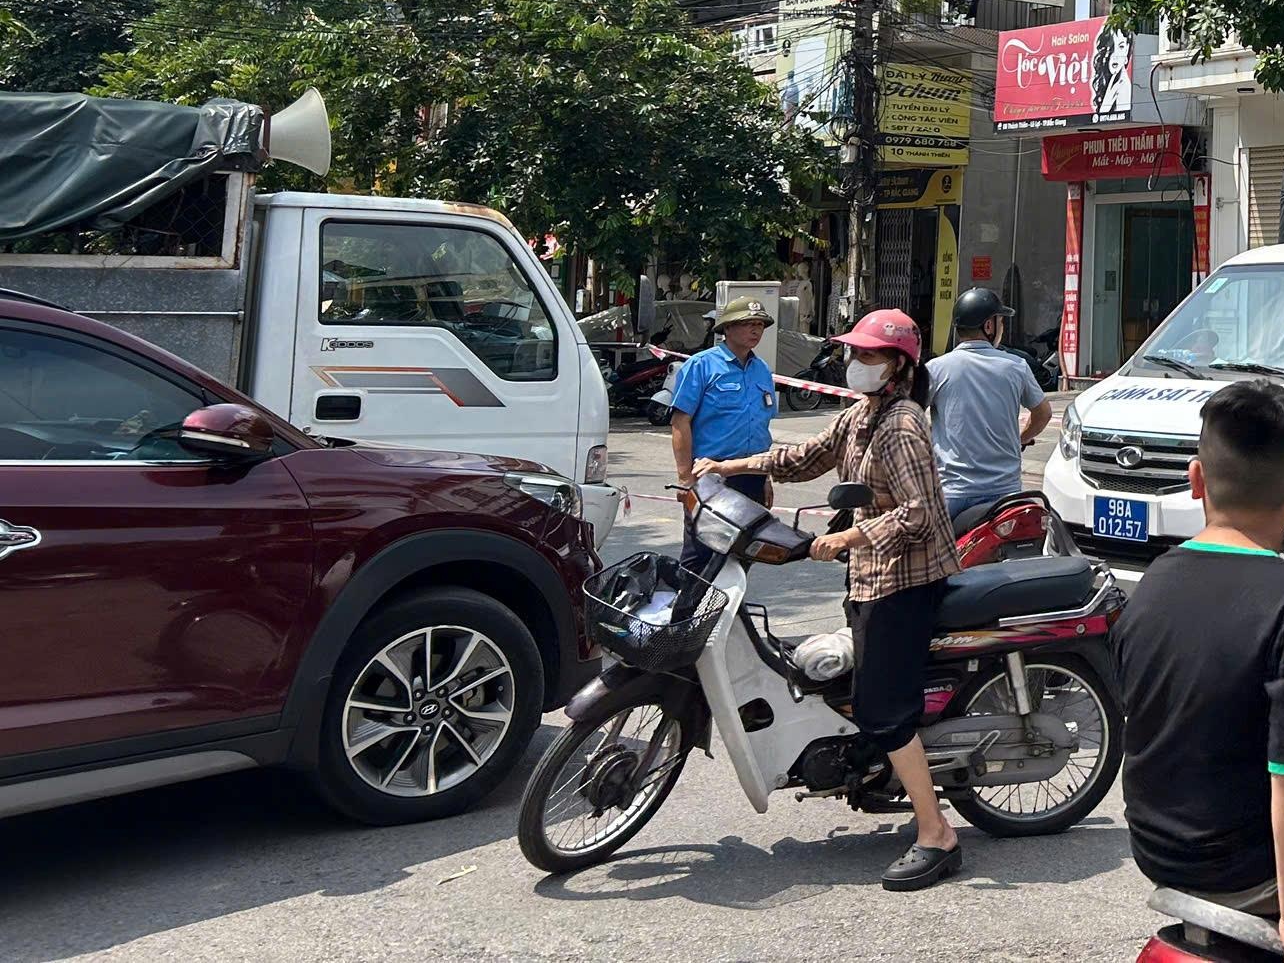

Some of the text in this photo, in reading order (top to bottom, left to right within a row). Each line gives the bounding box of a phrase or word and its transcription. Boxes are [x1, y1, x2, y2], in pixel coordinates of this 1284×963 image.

[1051, 33, 1090, 47] Hair Salon
[1002, 33, 1090, 95] Tóc Việt
[885, 136, 912, 144] 0979
[914, 138, 935, 146] 680
[1083, 139, 1105, 155] PHUN
[1130, 131, 1154, 150] THẨM
[1115, 154, 1134, 167] Mày
[1147, 385, 1191, 402] SÁT
[1108, 499, 1132, 518] 98A
[1098, 516, 1142, 538] 012.57
